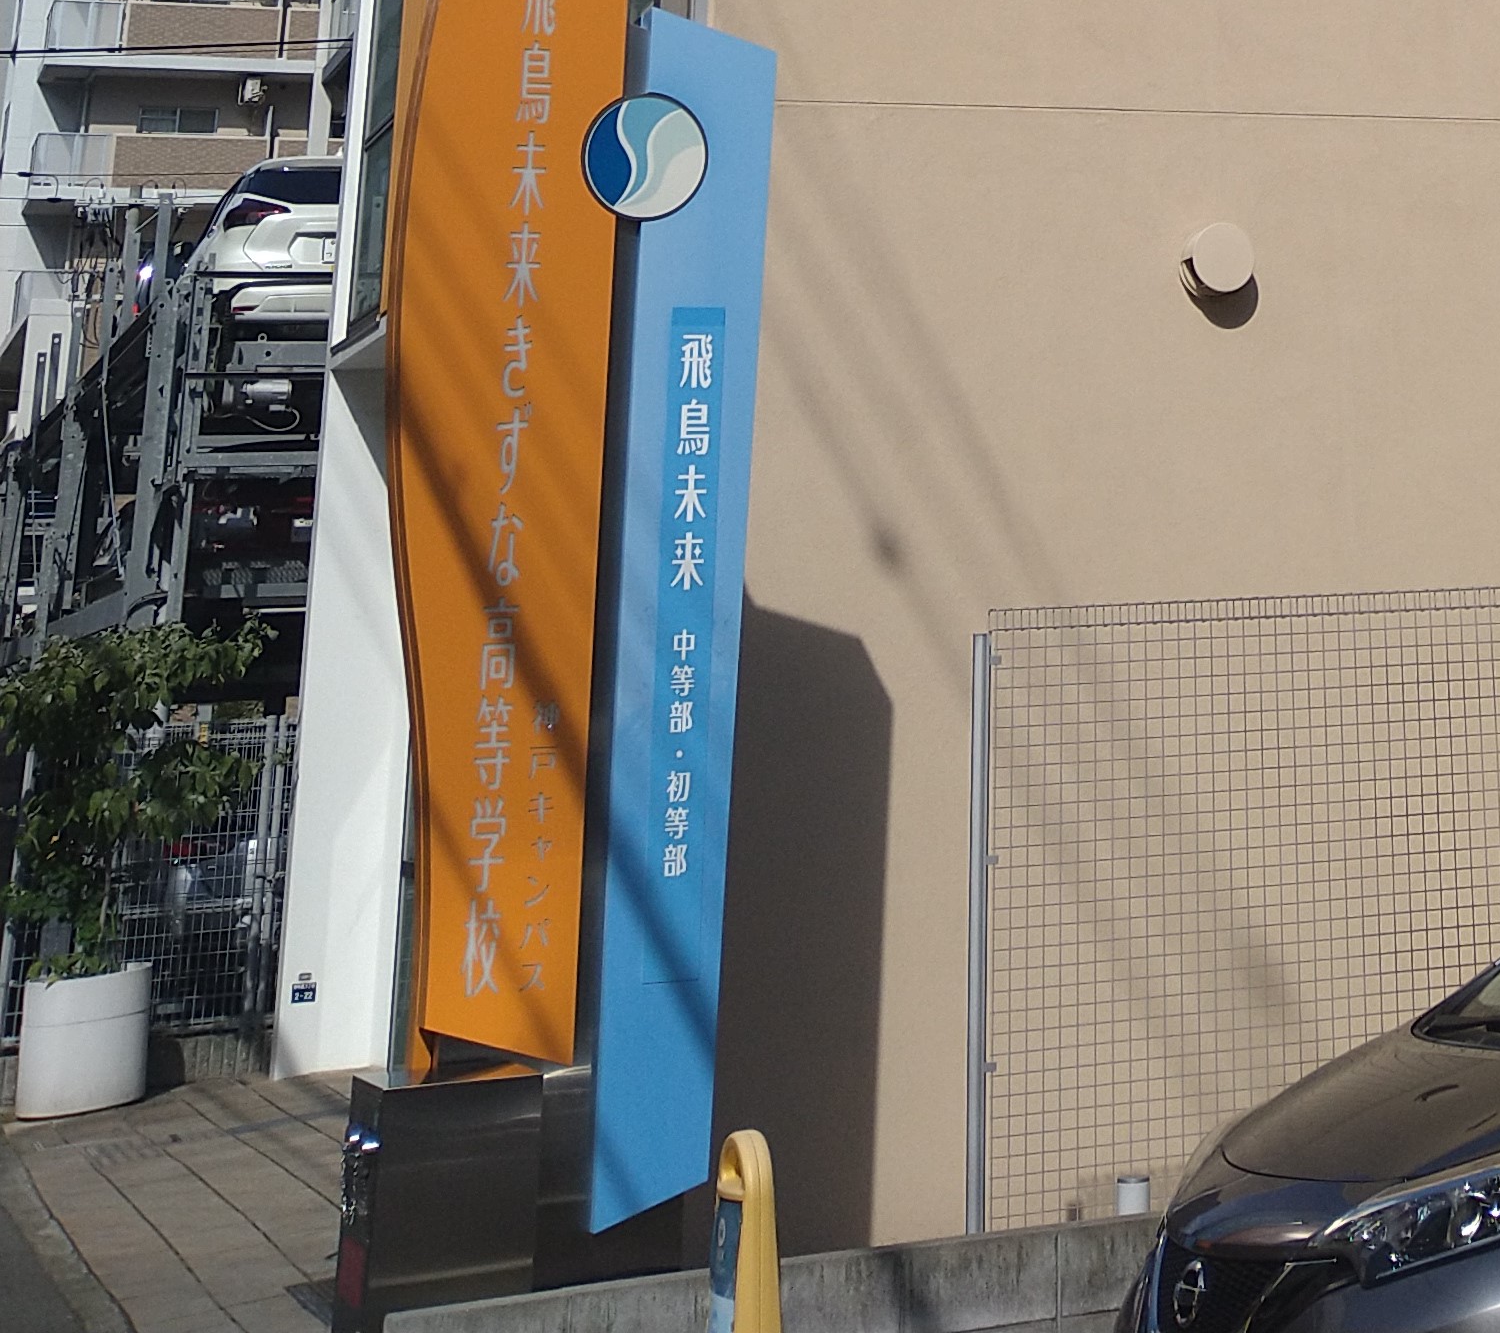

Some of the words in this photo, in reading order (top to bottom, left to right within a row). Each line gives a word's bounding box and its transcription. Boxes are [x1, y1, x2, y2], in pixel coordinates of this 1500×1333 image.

[669, 333, 713, 591] 飛鳥未来
[518, 699, 561, 993] 神戸キャンパス
